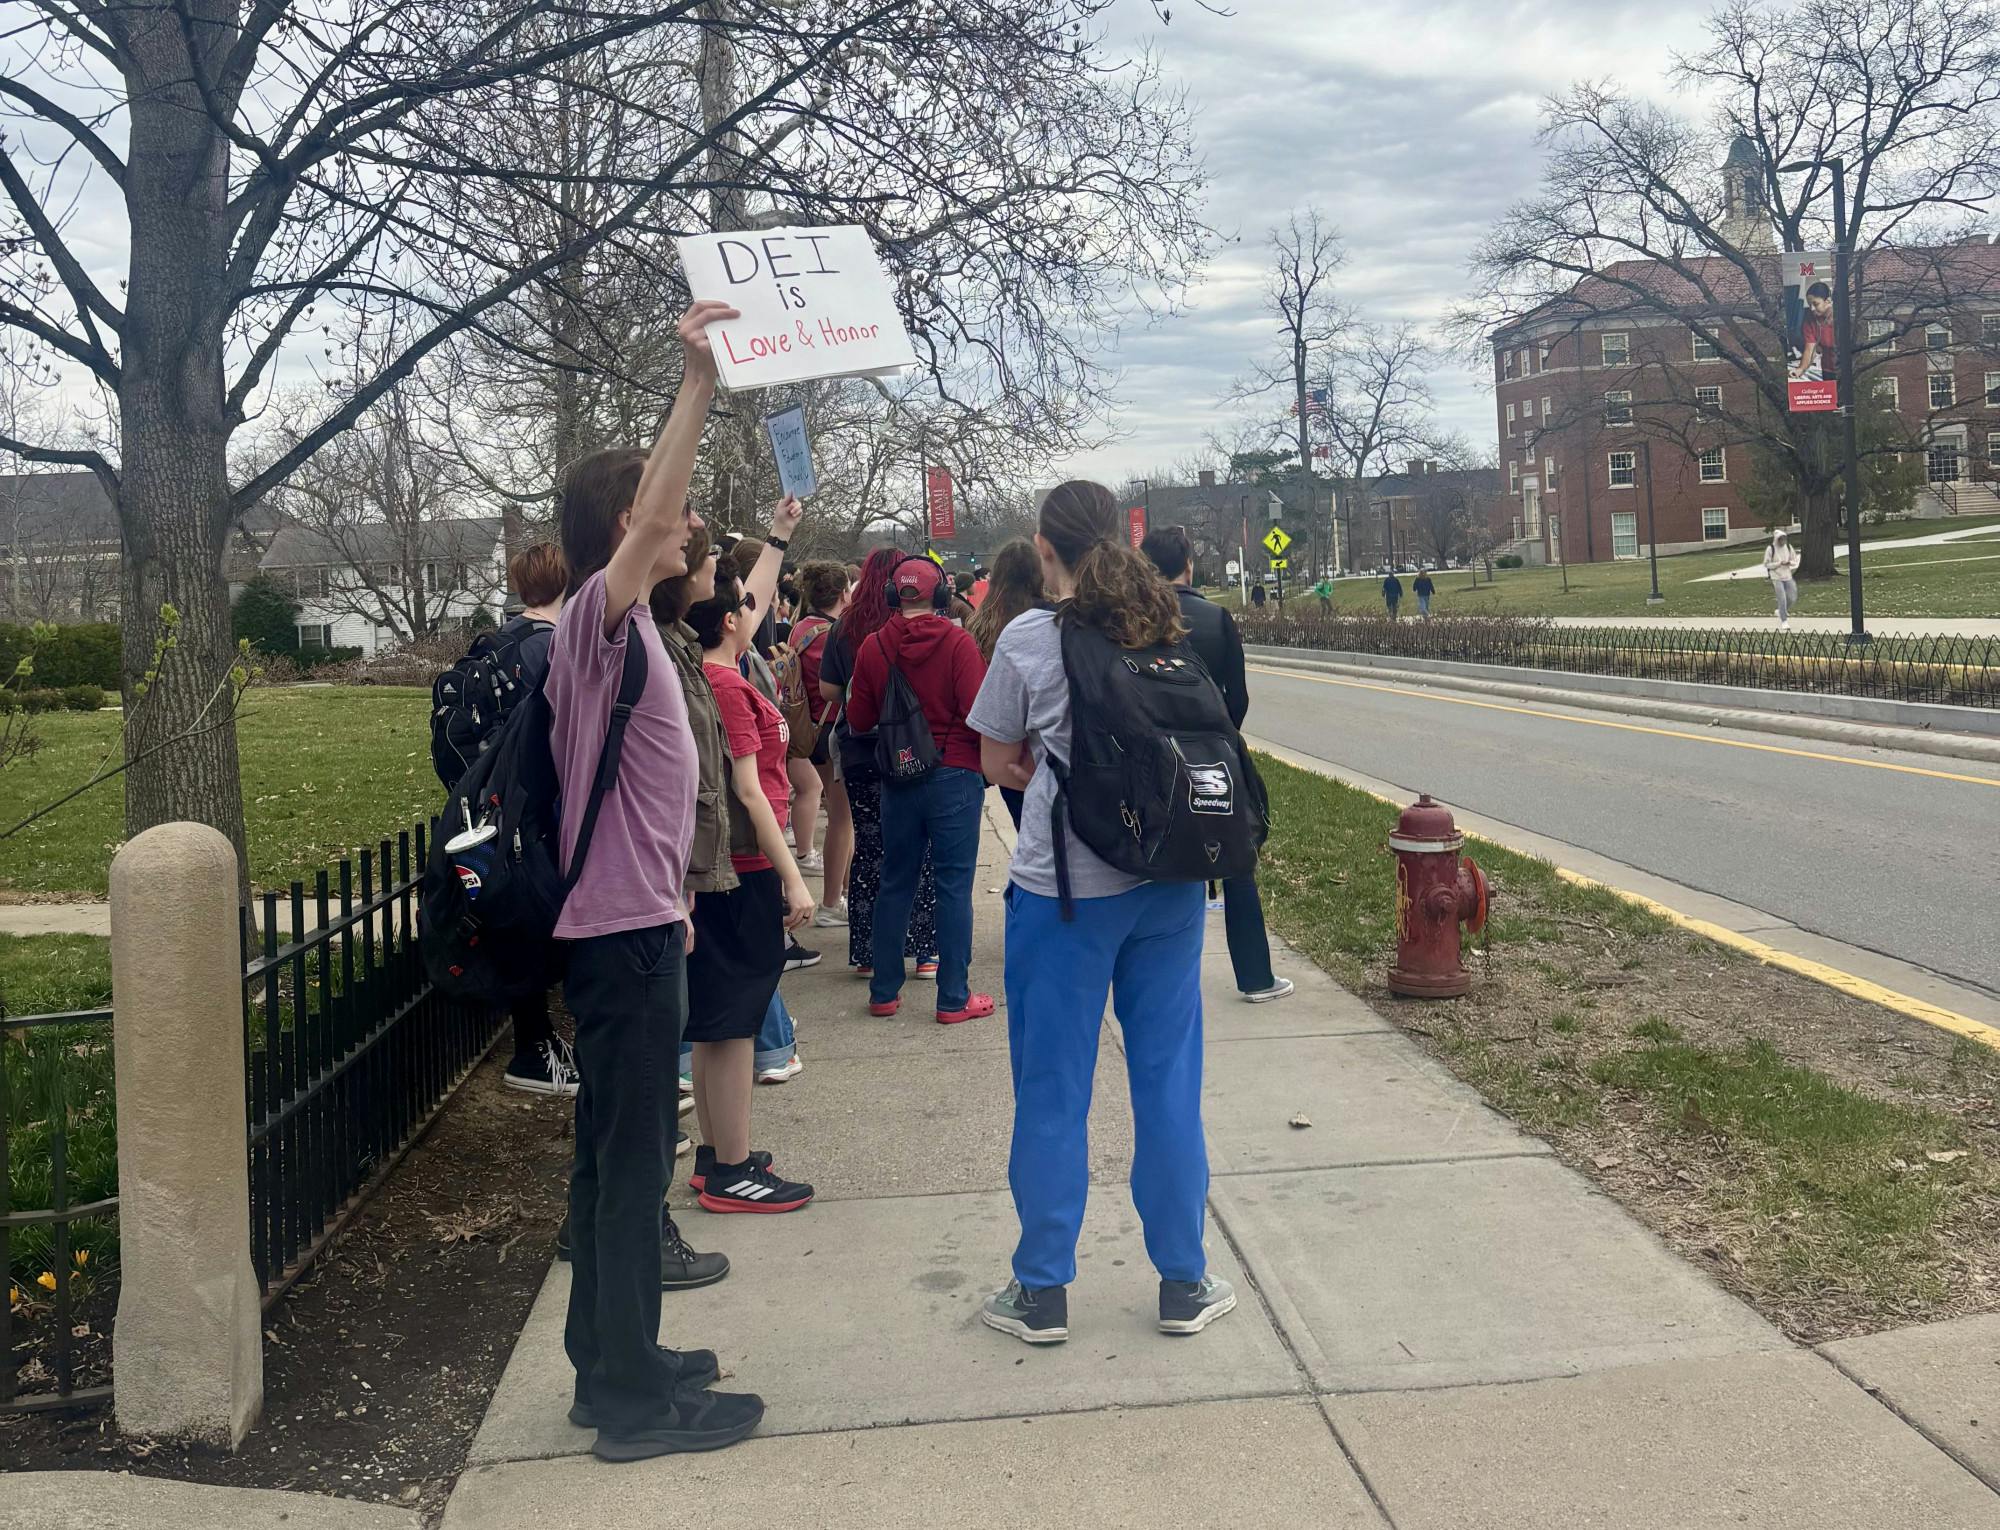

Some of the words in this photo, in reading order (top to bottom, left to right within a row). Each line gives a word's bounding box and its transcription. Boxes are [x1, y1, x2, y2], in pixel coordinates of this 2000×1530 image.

[717, 235, 841, 284] DEI
[776, 283, 806, 310] is
[721, 330, 792, 364] Love
[795, 319, 815, 349] &
[818, 316, 879, 346] Honor
[933, 489, 945, 527] MIAMI
[1193, 797, 1230, 809] Speedway
